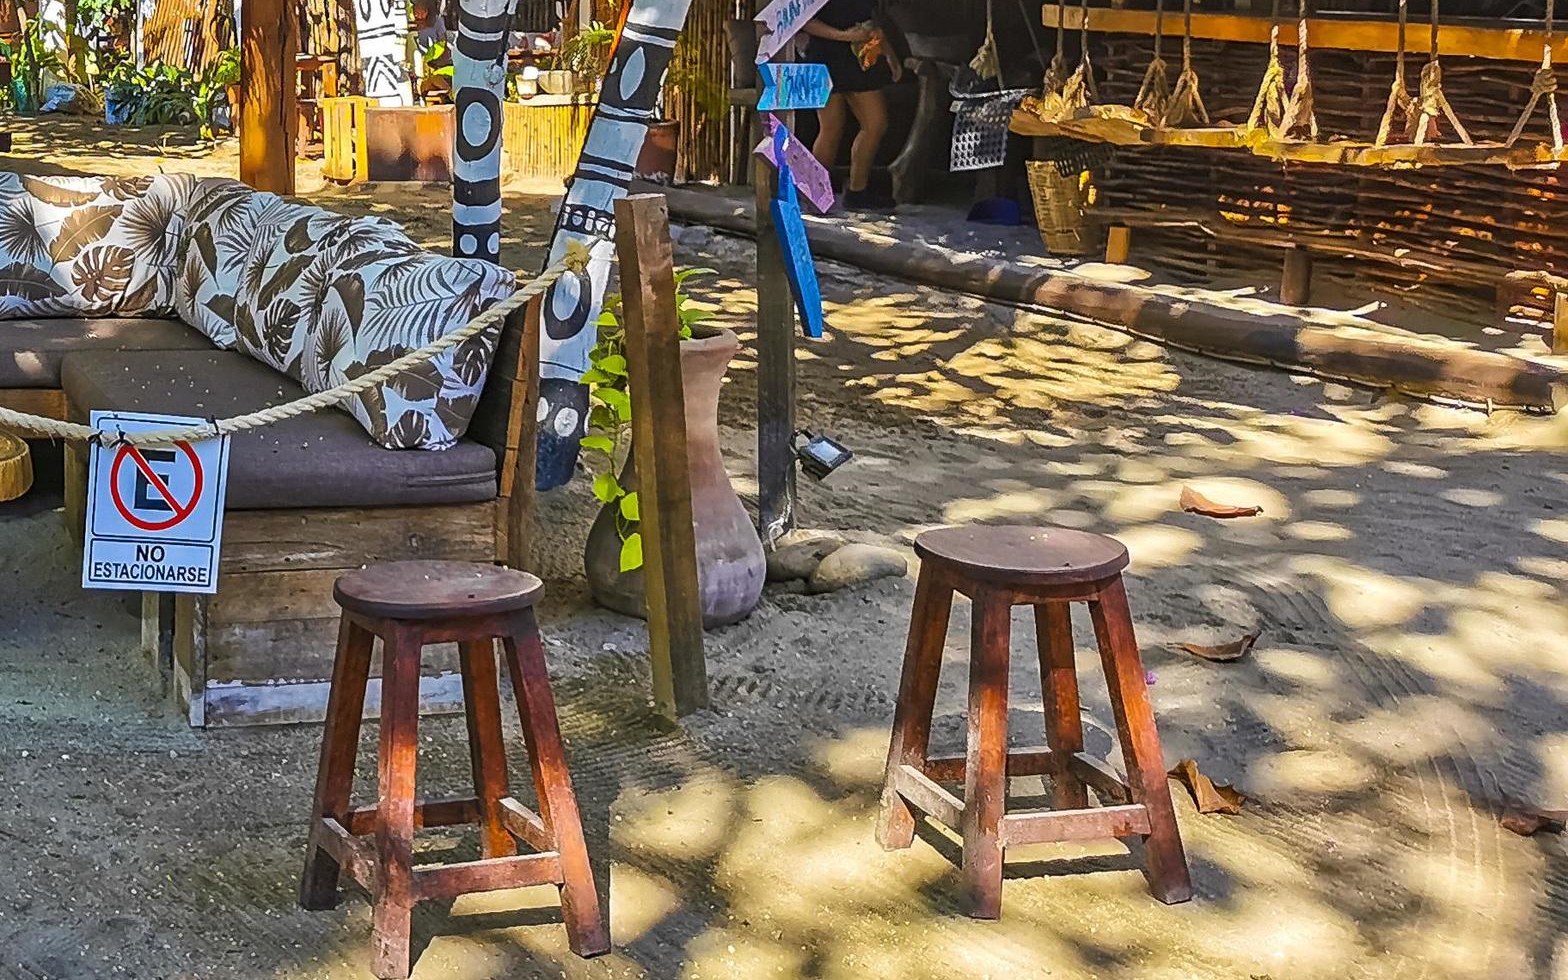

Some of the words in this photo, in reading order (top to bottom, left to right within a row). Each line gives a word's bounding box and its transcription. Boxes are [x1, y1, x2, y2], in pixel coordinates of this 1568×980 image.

[134, 448, 176, 511] E
[135, 545, 165, 562] NO
[93, 562, 207, 583] ESTACIONARSE
